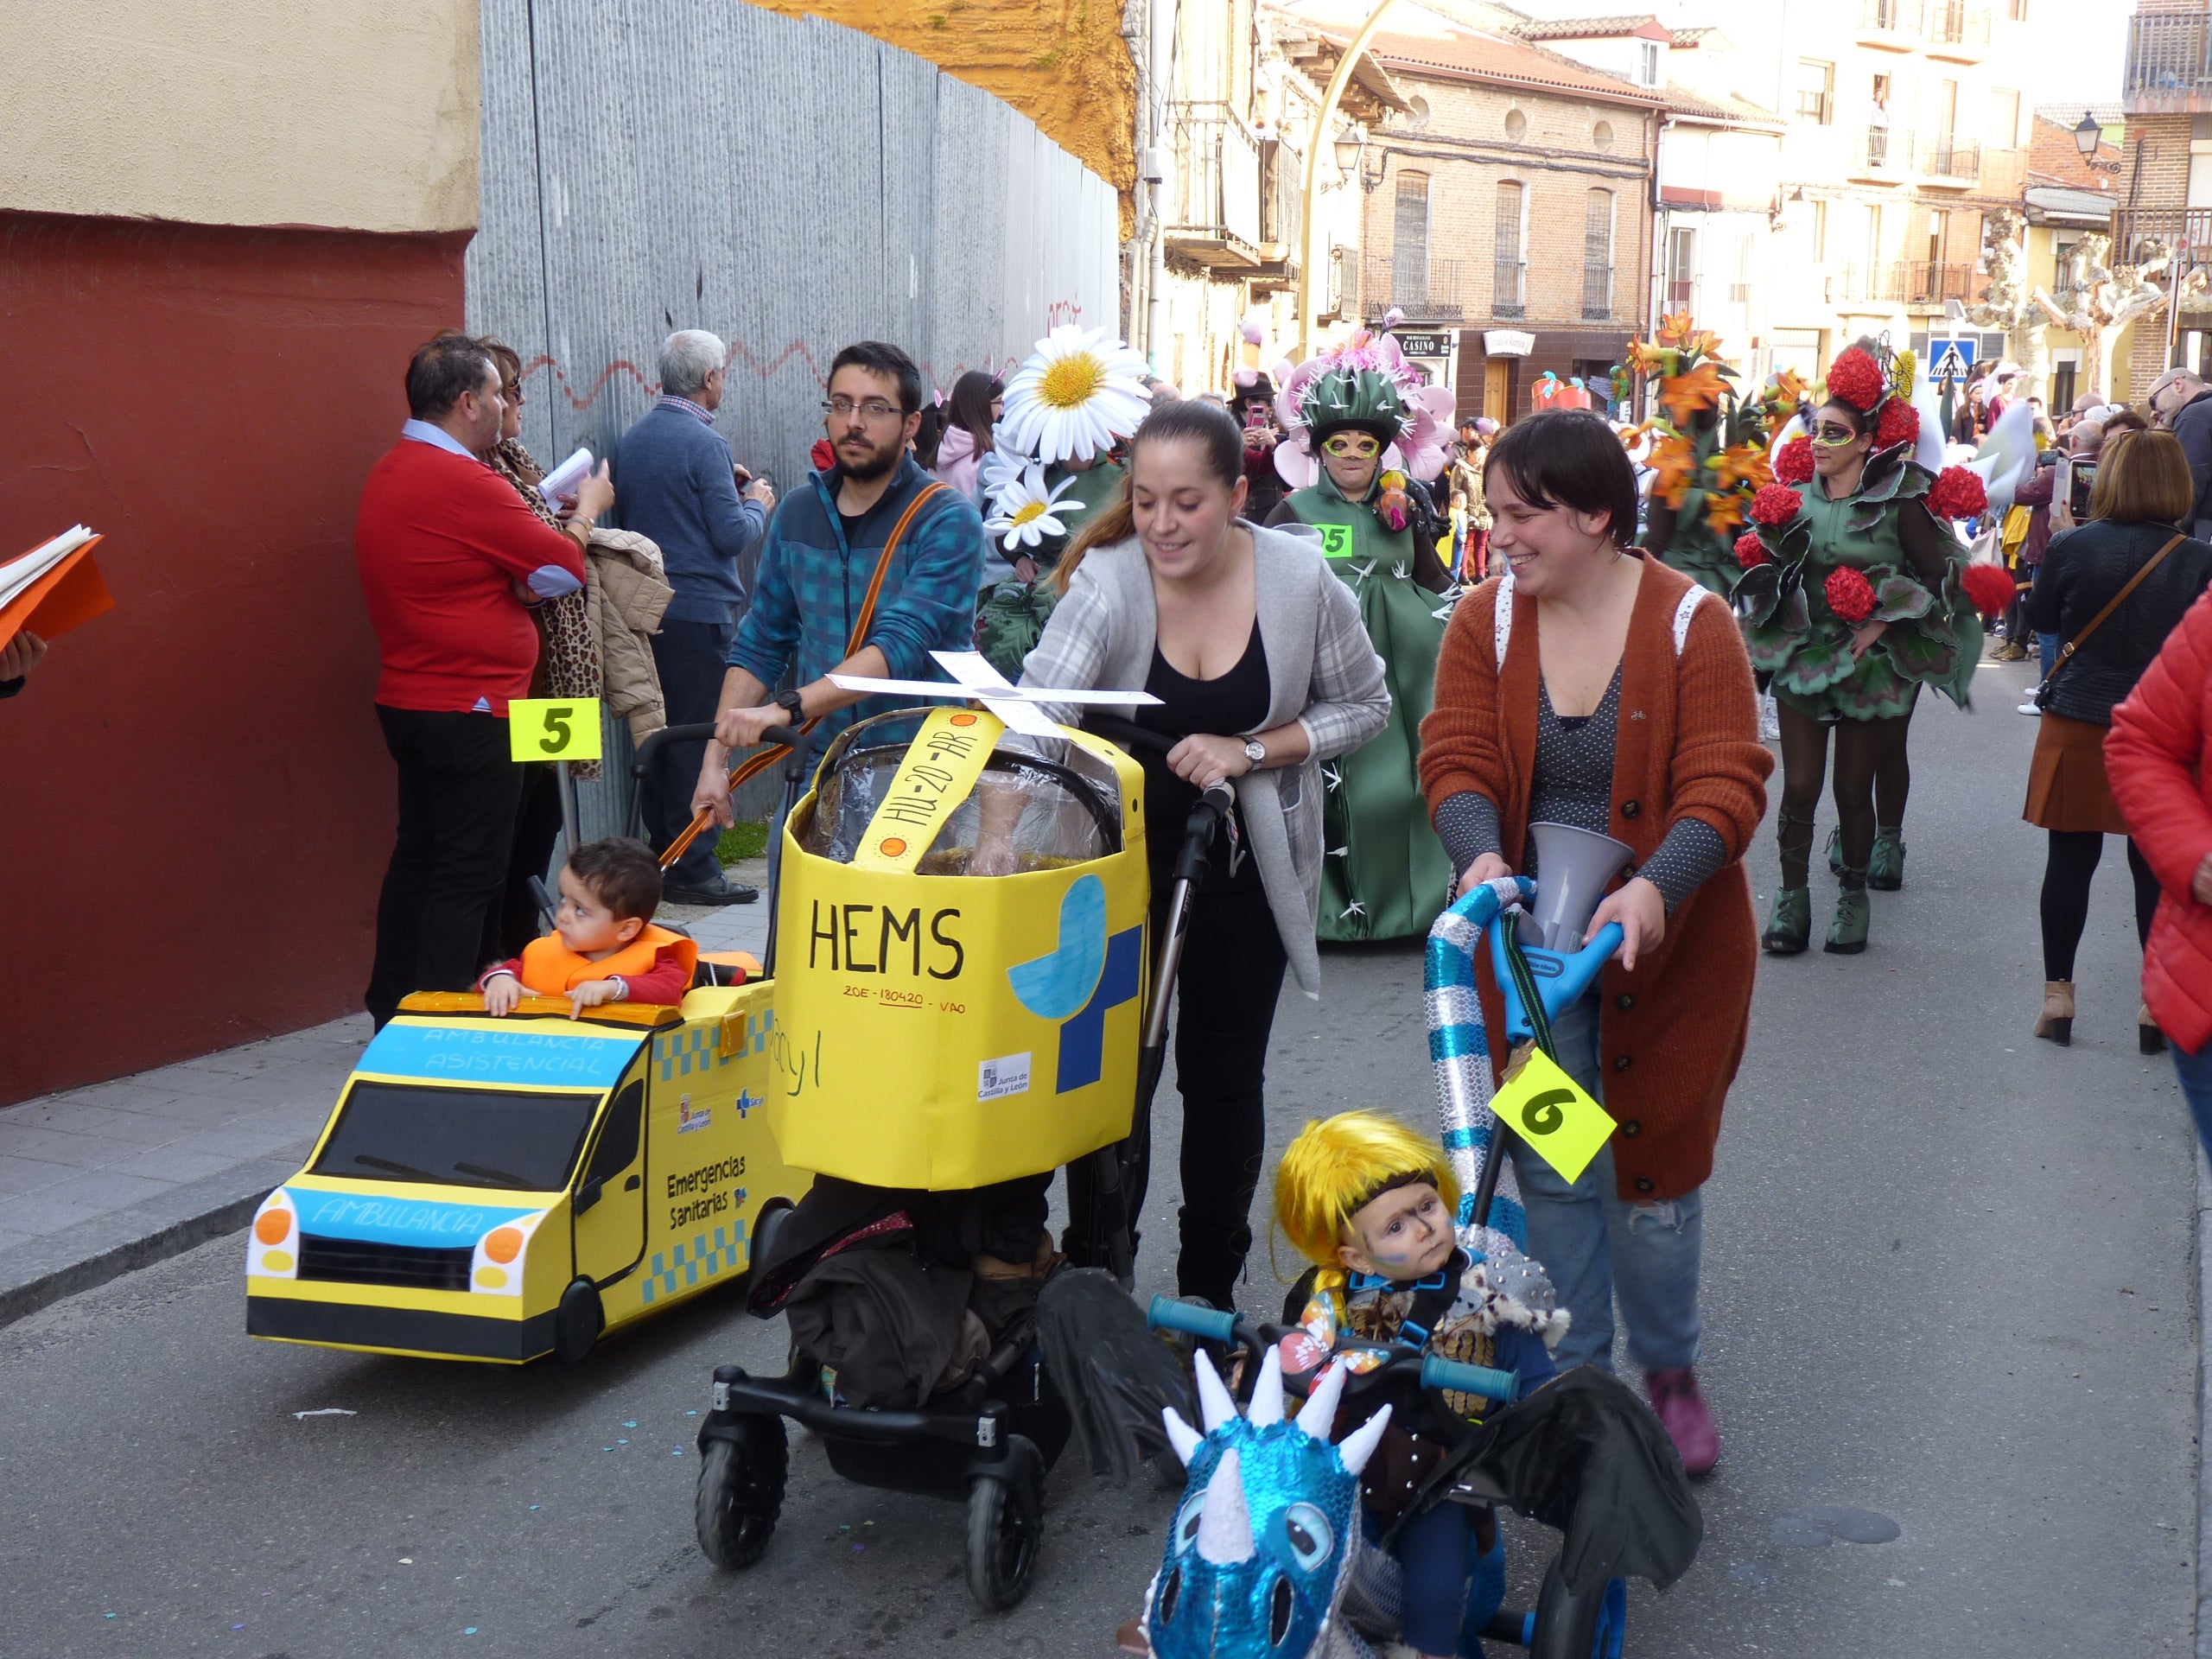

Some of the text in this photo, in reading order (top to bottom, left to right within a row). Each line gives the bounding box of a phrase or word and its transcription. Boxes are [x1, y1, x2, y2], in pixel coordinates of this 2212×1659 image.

[1402, 340, 1434, 351] CASINO
[539, 707, 573, 753] 5
[810, 899, 964, 981] HEMS
[978, 1082, 1028, 1098] Castilla y León
[998, 1072, 1028, 1085] Junta de
[1522, 1088, 1577, 1135] 6
[667, 1155, 746, 1199] Emergencias
[670, 1191, 728, 1230] Sanitarias
